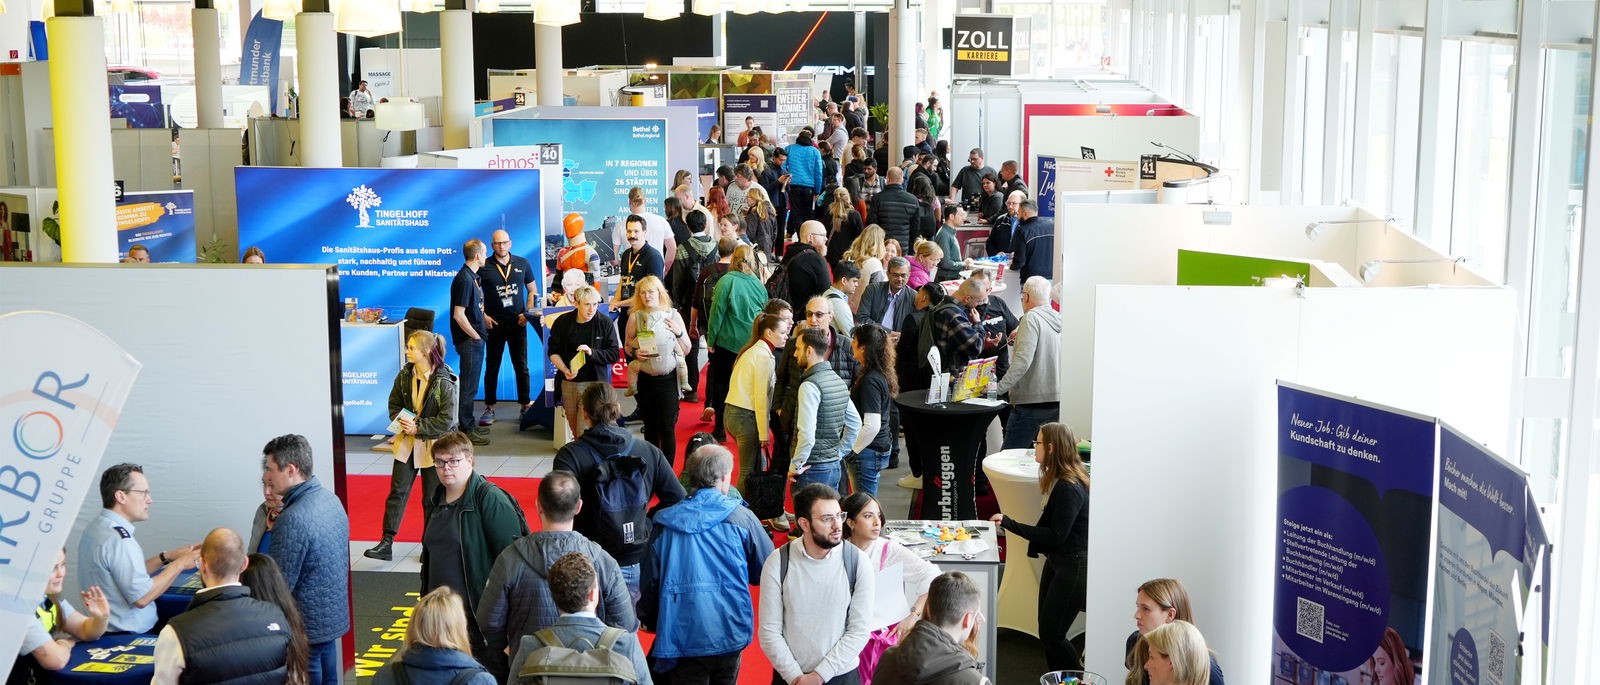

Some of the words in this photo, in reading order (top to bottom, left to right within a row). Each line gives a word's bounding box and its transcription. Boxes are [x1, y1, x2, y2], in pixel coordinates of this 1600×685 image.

[958, 30, 1008, 49] ZOLL
[250, 39, 261, 84] tmunder
[967, 51, 999, 60] KARRIERE
[261, 52, 272, 85] sbank
[488, 155, 535, 169] elmos
[542, 150, 557, 160] 40
[1044, 161, 1056, 170] Näc
[641, 168, 658, 176] ÜBER
[1142, 162, 1155, 174] 41
[626, 177, 658, 186] STÄDTEN
[375, 210, 429, 218] TINGELHOFF
[375, 218, 429, 227] SANITÄTSHAUS
[321, 246, 333, 254] Die
[335, 246, 404, 254] Sanitätshaus-Profis
[437, 247, 452, 255] Pott
[338, 258, 358, 266] stark,
[360, 258, 397, 266] nachhaltig
[398, 258, 412, 266] und
[413, 258, 441, 266] führend
[351, 269, 380, 277] Kunden,
[1290, 412, 1314, 429] Neuer
[1314, 420, 1334, 435] Job:
[1335, 424, 1350, 439] Gib
[1352, 429, 1378, 446] deiner
[1290, 430, 1336, 451] Kundschaft
[1336, 444, 1346, 453] zu
[1347, 446, 1381, 464] denken.
[1444, 456, 1461, 478] Bücher
[38, 453, 81, 534] GRUPPE
[933, 446, 955, 521] urbrüggen
[1444, 476, 1457, 494] Mach
[1456, 487, 1468, 500] mit!
[1283, 518, 1300, 529] Steige
[1300, 524, 1314, 534] jetzt
[1314, 528, 1323, 536] ein
[1323, 531, 1333, 540] als:
[1286, 530, 1306, 543] Leitung
[1307, 536, 1317, 545] der
[1317, 539, 1353, 559] Buchhandlung
[1353, 552, 1377, 567] (m/w/d)
[1286, 538, 1328, 558] Stellvertretende
[1328, 553, 1348, 567] Leitung
[1348, 560, 1357, 569] der
[1285, 556, 1318, 572] Buchhändler
[1318, 567, 1339, 581] (m/w/d)
[1286, 547, 1323, 566] Buchhandlung
[1323, 560, 1344, 574] (m/w/d)
[1285, 565, 1315, 580] Mitarbeiter
[1315, 575, 1322, 583] im
[1322, 578, 1342, 590] Verkauf
[1342, 585, 1365, 600] (m/w/d)
[1285, 573, 1314, 589] Mitarbeiter
[1314, 584, 1322, 592] im
[1322, 587, 1359, 608] Wareneingang
[1359, 601, 1382, 616] (m/w/d)
[355, 645, 398, 677] Wir
